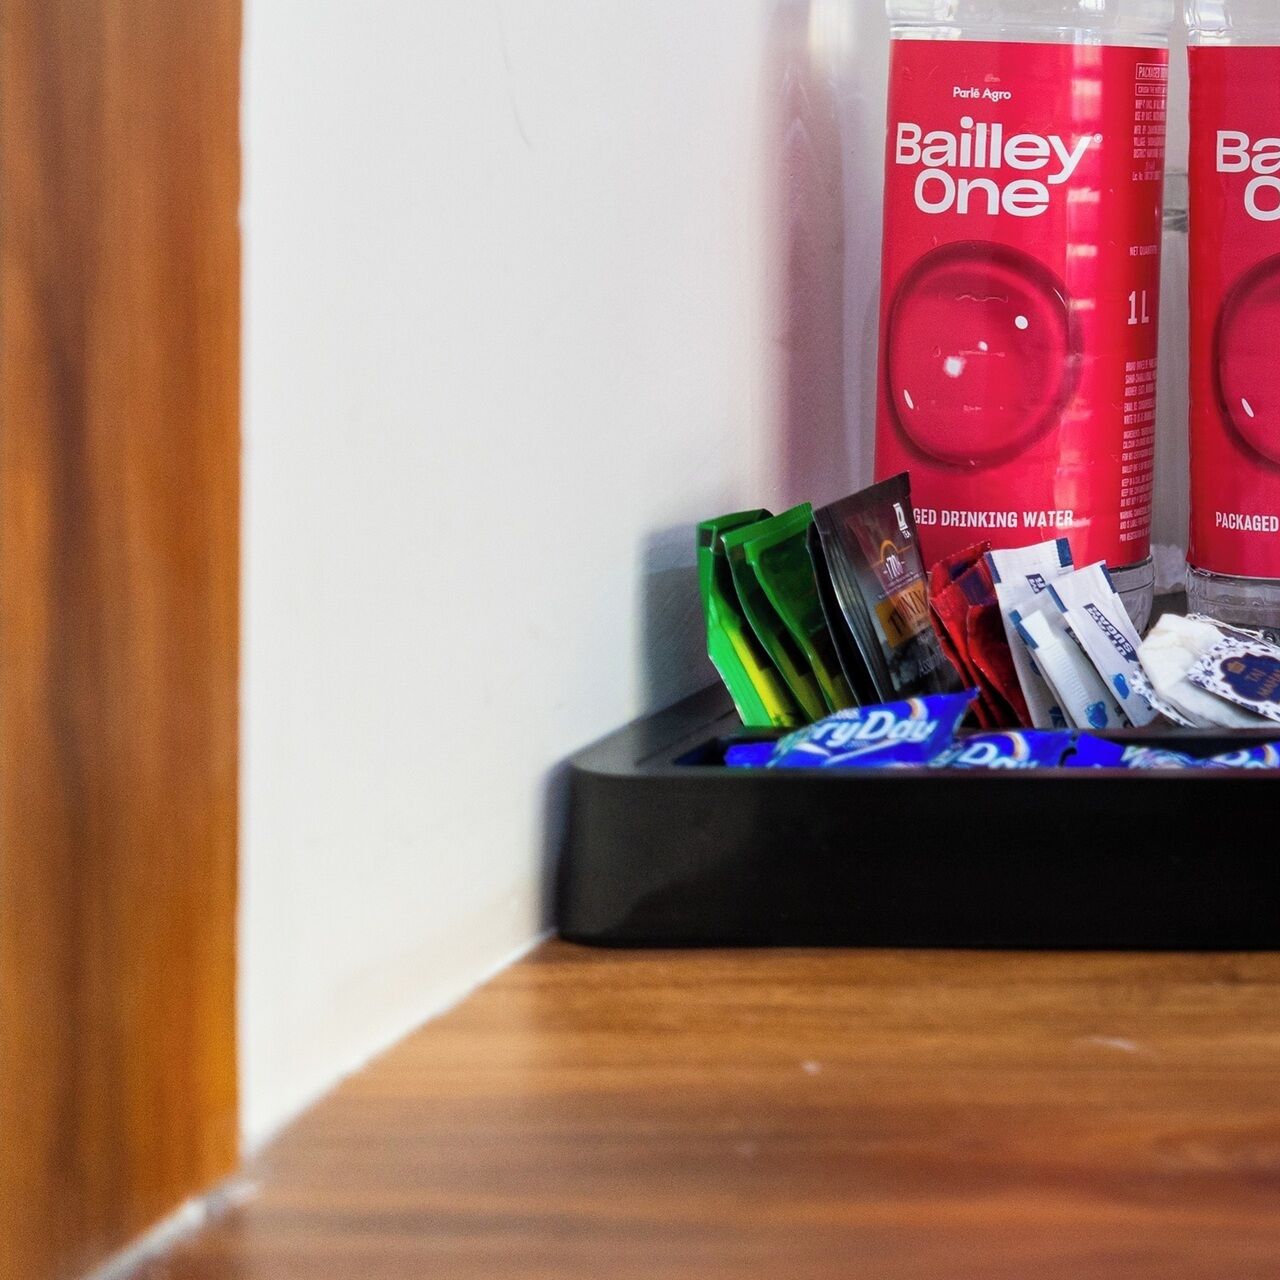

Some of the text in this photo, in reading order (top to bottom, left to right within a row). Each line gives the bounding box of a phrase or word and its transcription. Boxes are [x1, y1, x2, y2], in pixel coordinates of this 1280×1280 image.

[982, 88, 1012, 102] Agro
[895, 116, 1092, 184] Bailley
[914, 168, 1050, 217] One
[941, 510, 1018, 528] DRINKING
[1023, 509, 1073, 528] WATER
[1215, 511, 1279, 532] PACKAGED
